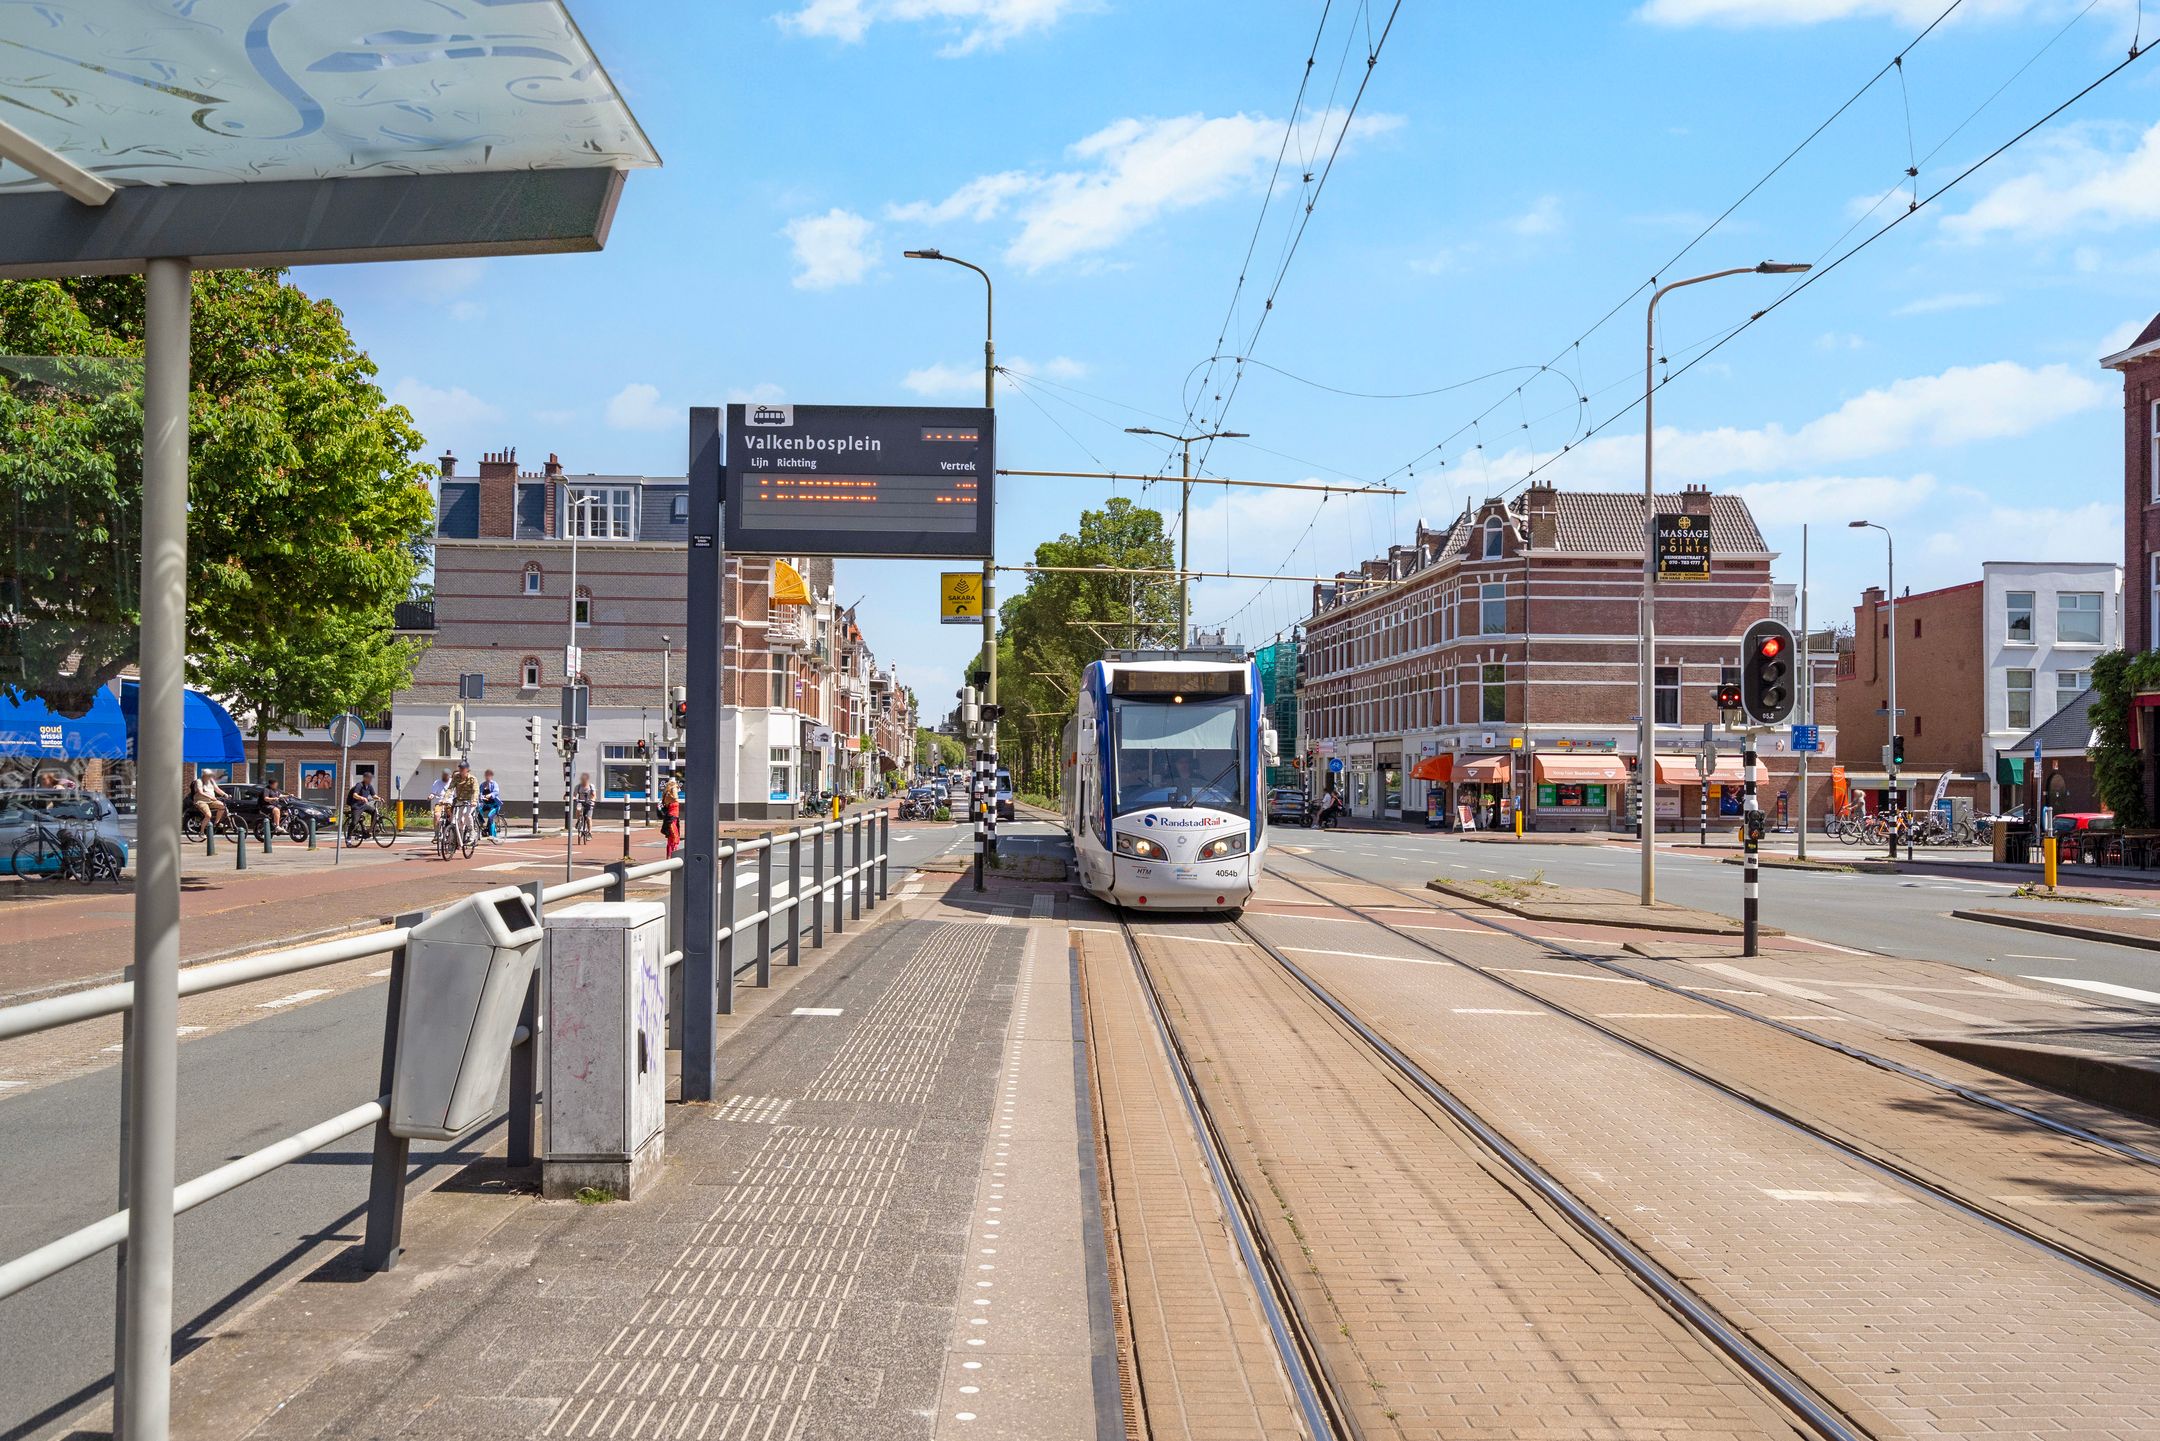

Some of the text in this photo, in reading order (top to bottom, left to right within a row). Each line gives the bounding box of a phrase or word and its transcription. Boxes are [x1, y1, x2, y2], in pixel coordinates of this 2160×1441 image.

[744, 434, 882, 455] Valkenbosplein
[751, 457, 817, 470] Lijn Richting
[940, 460, 976, 471] Vertrek
[1660, 529, 1709, 538] MASSAGE
[1660, 545, 1708, 553] POINTS
[40, 725, 62, 734] goud
[40, 732, 63, 740] wissel
[1160, 817, 1221, 827] RandstadRail
[1215, 869, 1238, 877] 4054b
